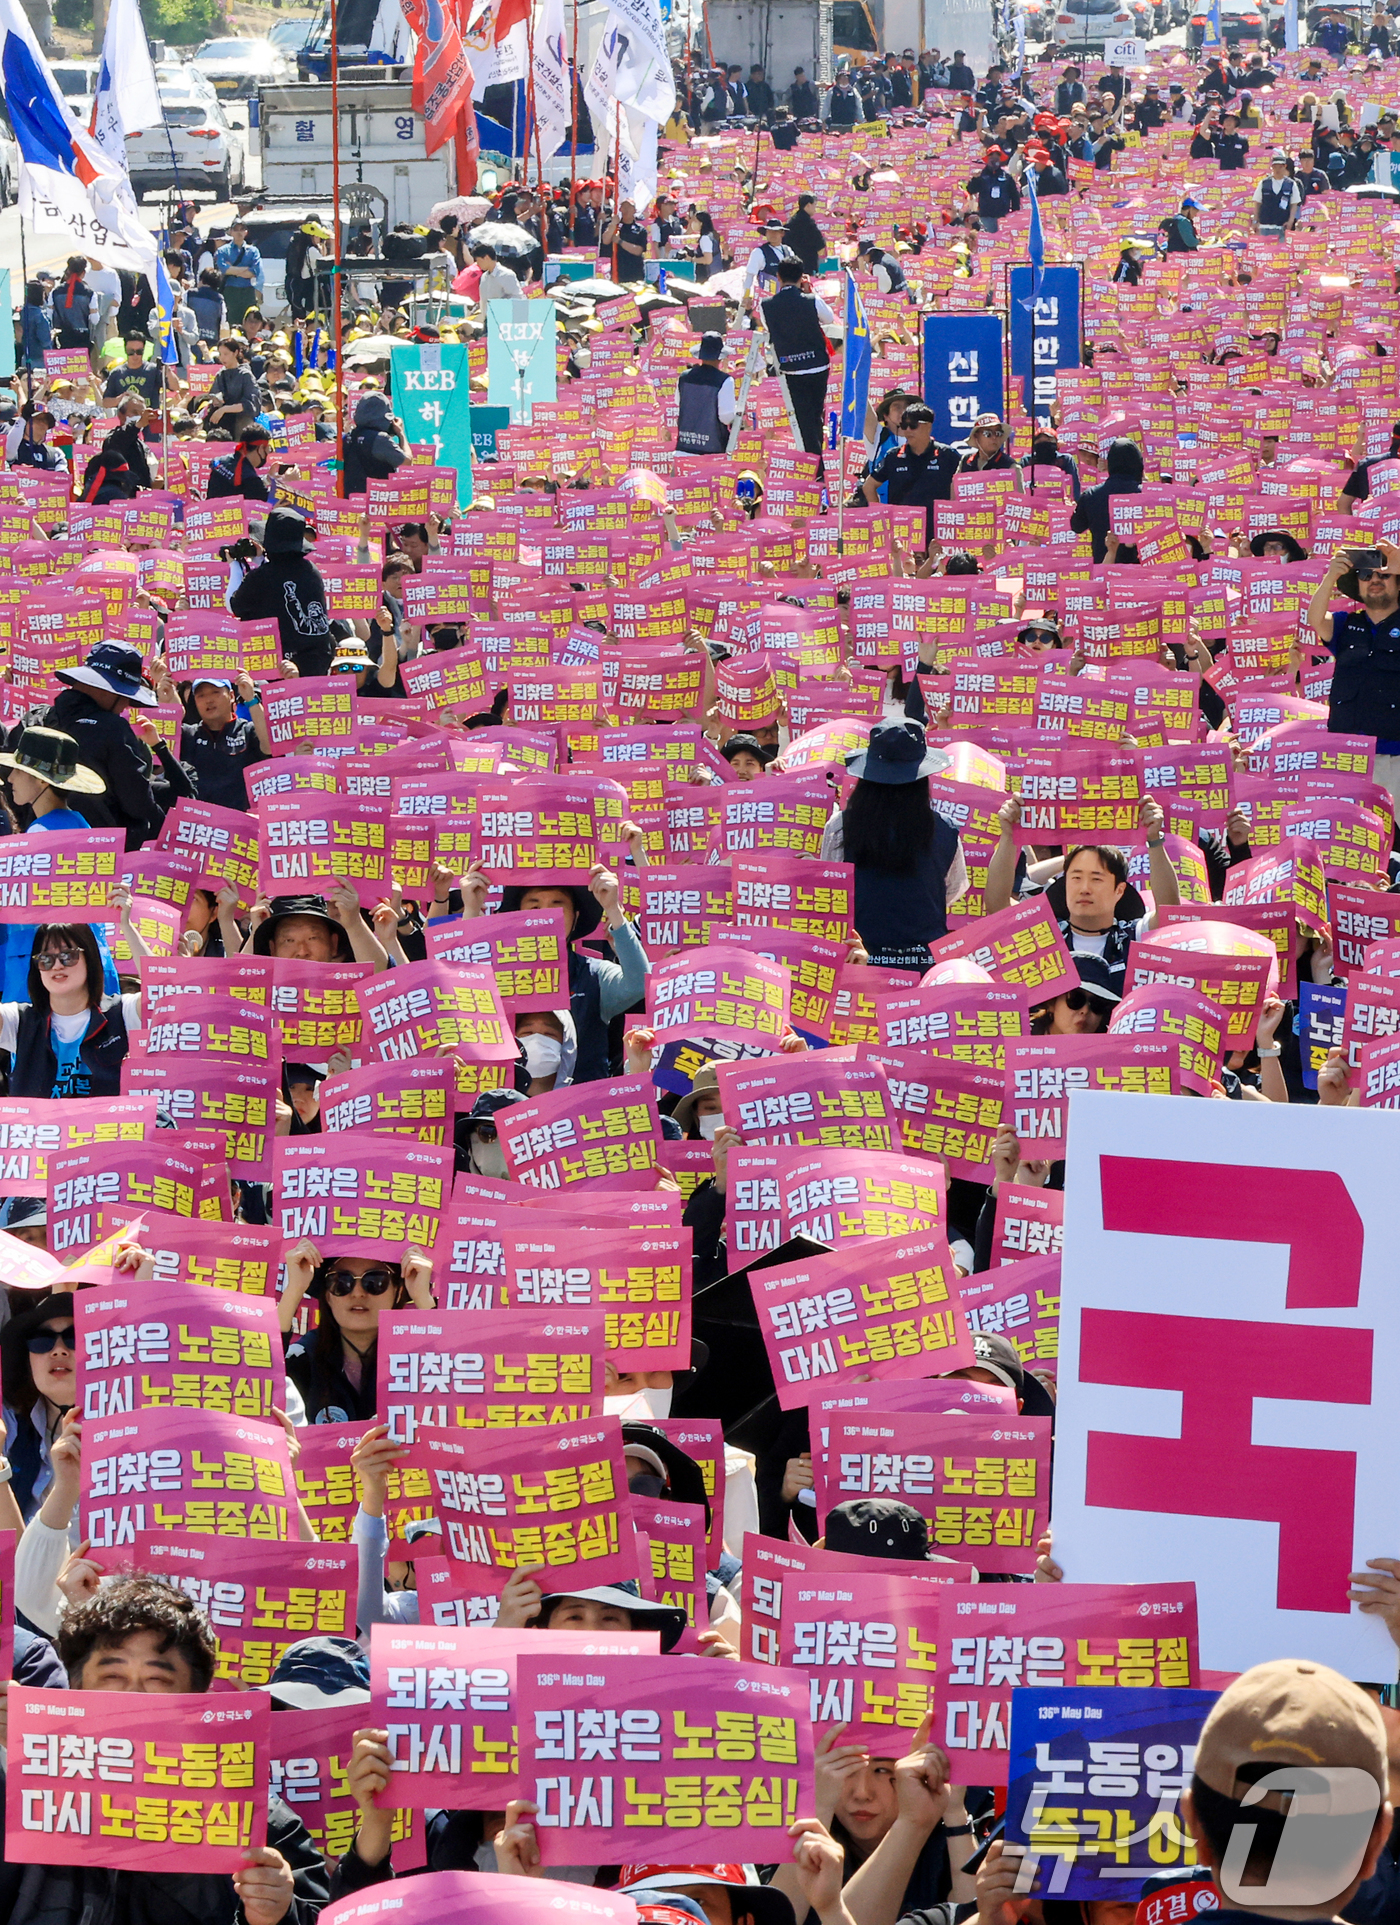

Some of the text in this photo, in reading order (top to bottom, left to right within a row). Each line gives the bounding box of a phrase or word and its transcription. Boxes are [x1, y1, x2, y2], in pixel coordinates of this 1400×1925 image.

[1114, 41, 1136, 56] citi
[394, 116, 414, 140] 영
[404, 370, 456, 391] KEB
[369, 489, 399, 501] 되찾은
[369, 503, 387, 516] 다시
[937, 513, 965, 526] 되찾은
[545, 546, 609, 559] 되찾은 노동절
[545, 562, 608, 575] 다시 노동중심!
[405, 584, 469, 602] 되찾은 노동절
[892, 593, 966, 614] 되찾은 노동절
[613, 598, 686, 620] 되찾은 노동절
[168, 633, 239, 653] 되찾은 노동절
[513, 682, 598, 700] 되찾은 노동절
[621, 670, 701, 691] 되찾은 노동절
[268, 694, 352, 721] 되찾은 노동절
[513, 704, 598, 722] 다시 노동중심!
[647, 690, 698, 711] 노동중심!
[1039, 692, 1129, 721] 되찾은 노동절
[270, 721, 292, 744] 다시
[292, 716, 352, 737] 노동중심!
[1274, 752, 1369, 774] 되찾은 노동절
[1020, 774, 1139, 802] 되찾은 노동절
[481, 810, 593, 839] 되찾은 노동절
[725, 801, 828, 829] 되찾은 노동절
[1019, 805, 1140, 831] 다시 노동중심!
[267, 819, 385, 849] 되찾은 노동절
[55, 852, 116, 876] 노동절
[271, 851, 385, 880] 다시 노동중심!
[482, 843, 595, 869] 다시 노동중심!
[992, 918, 1054, 965] 노동절
[368, 986, 496, 1035] 되찾은 노동절
[738, 1089, 887, 1132] 되찾은 노동절
[52, 1171, 193, 1218] 되찾은 노동절
[281, 1166, 443, 1211] 되찾은 노동절
[281, 1205, 440, 1249] 다시 노동중심!
[515, 1265, 682, 1304] 되찾은 노동절
[767, 1265, 950, 1341] 되찾은 노동절
[83, 1322, 272, 1372] 되찾은 노동절
[778, 1310, 958, 1384] 다시 노동중심!
[387, 1351, 592, 1394] 되찾은 노동절
[1079, 1155, 1373, 1615] 국
[879, 1427, 895, 1437] Day
[1004, 1430, 1035, 1441] 한국노총
[89, 1448, 287, 1500] 되찾은 노동절
[839, 1453, 1037, 1498] 되찾은 노동절
[433, 1459, 617, 1518] 되찾은 노동절
[445, 1511, 619, 1570] 다시 노동중심!
[979, 1602, 995, 1615] May
[997, 1602, 1016, 1615] Day
[1152, 1601, 1184, 1616] 한국노총
[948, 1635, 1190, 1689] 되찾은 노동절
[536, 1673, 791, 1697] 136th May Day 한국노총
[25, 1702, 253, 1723] 136th May Day 한국노총
[1038, 1707, 1102, 1720] 136th May Day
[534, 1709, 798, 1765] 되찾은 노동절
[21, 1733, 255, 1789] 되찾은 노동절
[534, 1775, 797, 1829] 다시 노동중심!
[20, 1788, 254, 1848] 다시 노동중심!
